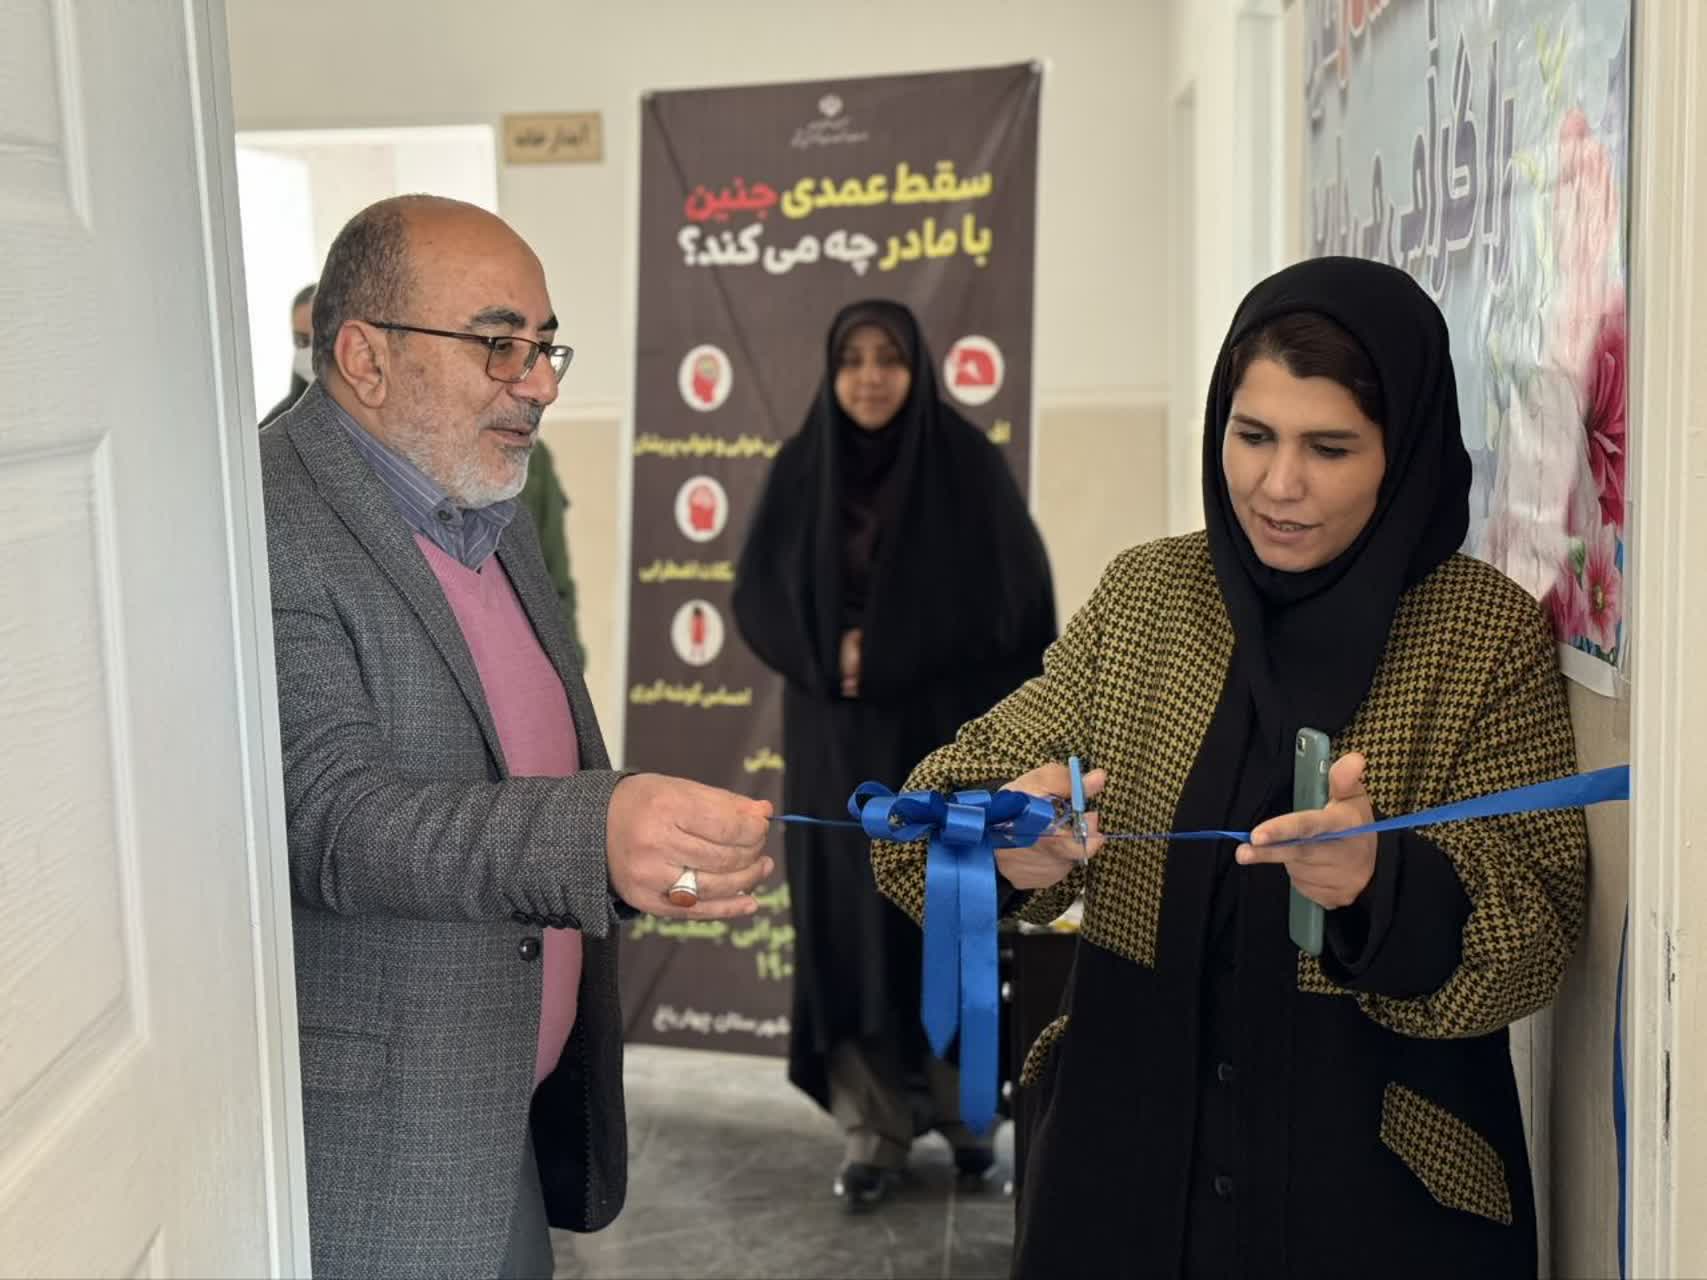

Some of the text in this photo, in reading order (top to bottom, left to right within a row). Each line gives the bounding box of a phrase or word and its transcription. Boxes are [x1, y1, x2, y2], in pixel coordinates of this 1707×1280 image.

[685, 161, 992, 221] سقط عمدی جنین
[824, 229, 878, 277] چه
[878, 217, 957, 270] مادر
[962, 212, 992, 267] با
